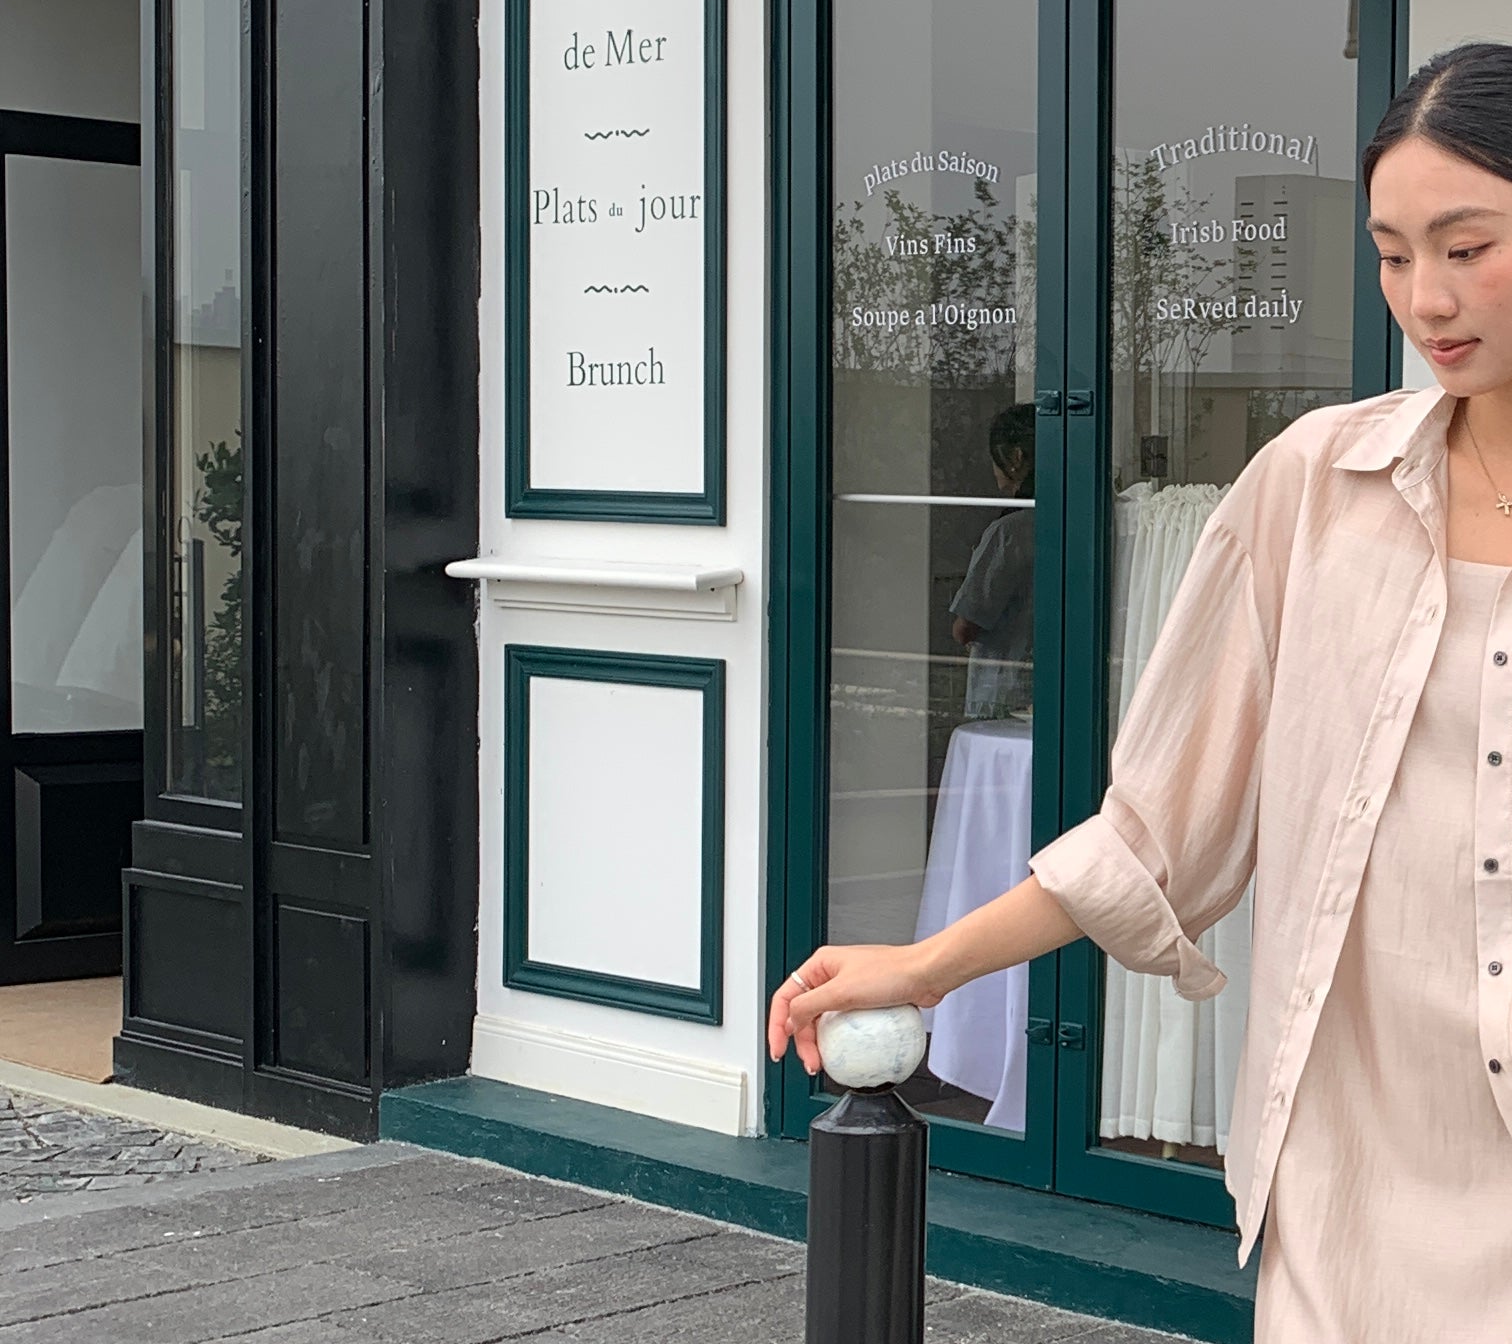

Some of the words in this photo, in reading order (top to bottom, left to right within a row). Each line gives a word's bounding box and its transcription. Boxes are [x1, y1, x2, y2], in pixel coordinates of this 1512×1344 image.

[563, 31, 596, 71] de
[604, 28, 667, 67] Mer
[1150, 122, 1317, 172] Traditional
[862, 158, 909, 197] plats
[911, 151, 934, 173] du
[938, 150, 1000, 184] Saison
[533, 187, 598, 225] Plats
[608, 202, 624, 217] du
[634, 184, 701, 233] jour
[1231, 216, 1286, 242] Food
[885, 233, 929, 257] Vins
[934, 232, 977, 255] Fins
[851, 306, 909, 333] Soupe
[914, 309, 926, 325] a
[931, 303, 1017, 330] l'Oignon
[1244, 288, 1303, 324] daily
[566, 346, 665, 387] Brunch
